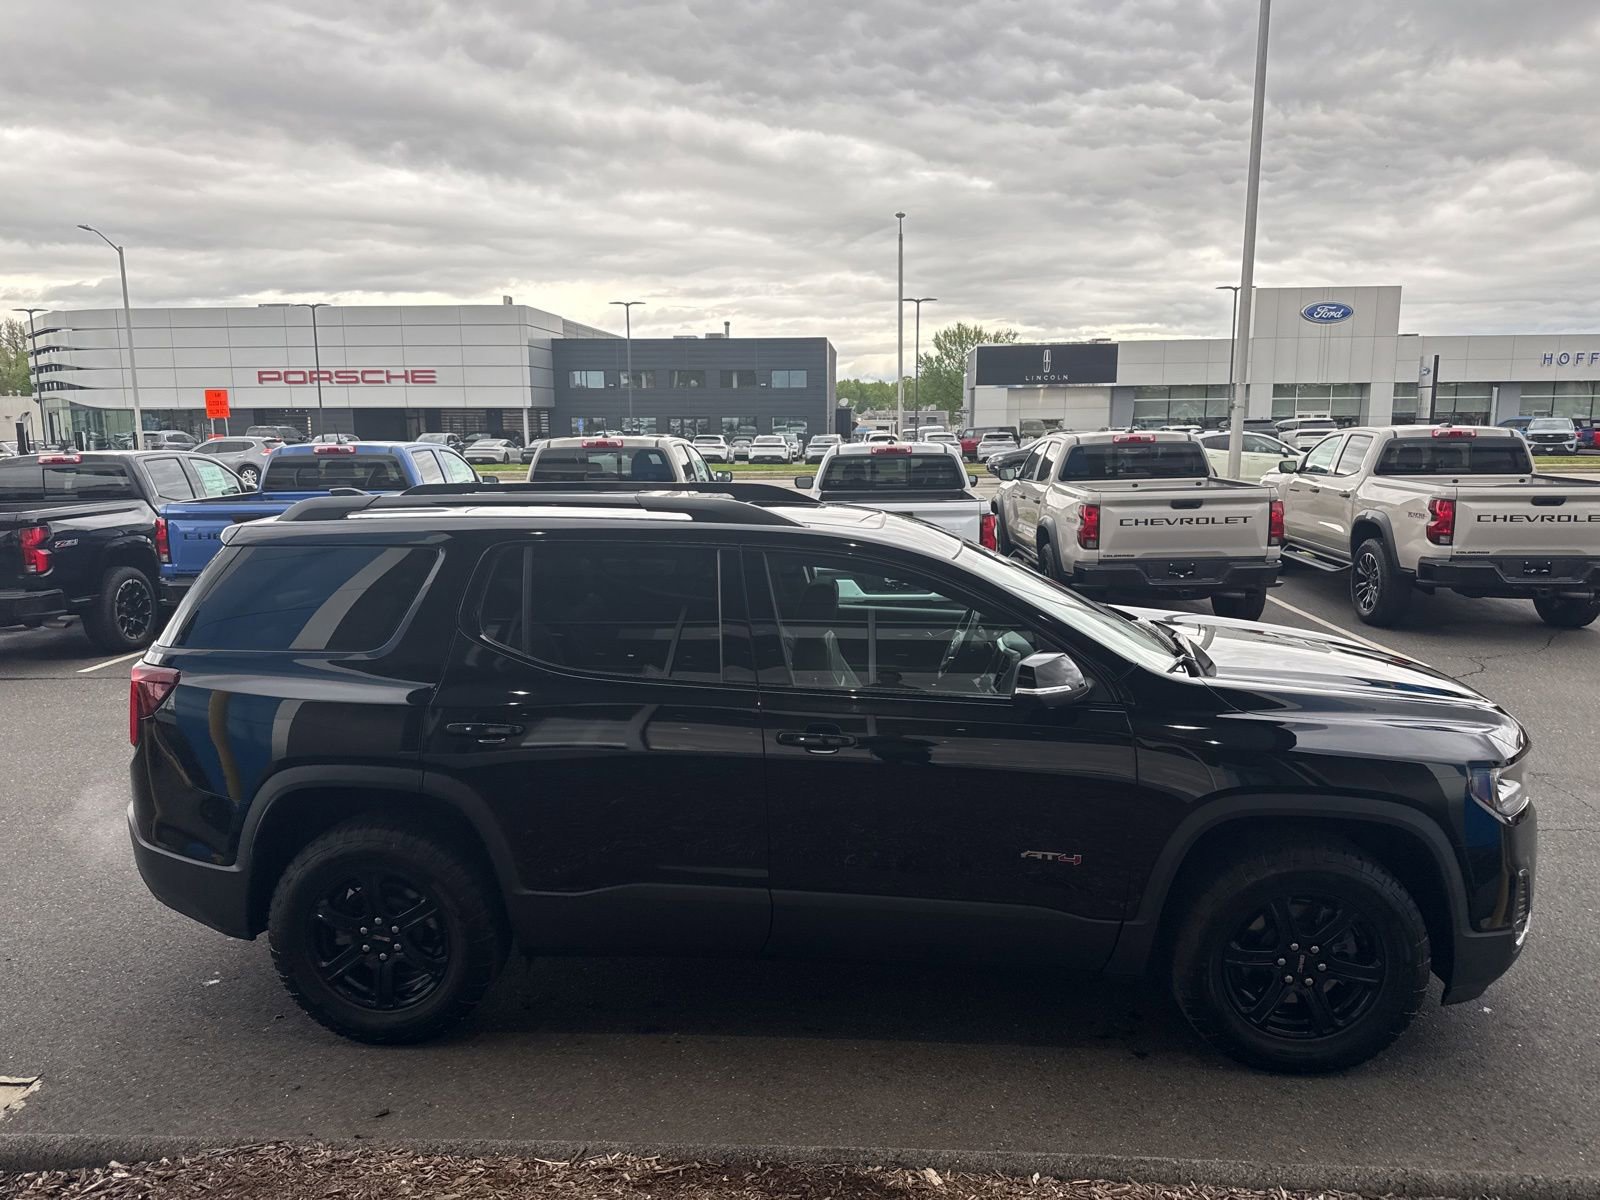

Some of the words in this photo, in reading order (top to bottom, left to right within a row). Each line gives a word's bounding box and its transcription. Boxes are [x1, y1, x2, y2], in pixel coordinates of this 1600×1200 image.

[1313, 305, 1345, 319] Ford
[1542, 352, 1600, 365] HOFF
[257, 369, 437, 385] PORSCHE
[1119, 515, 1253, 527] CHEVROLET
[1476, 514, 1600, 523] CHEVROLE
[1020, 850, 1082, 866] AT4
